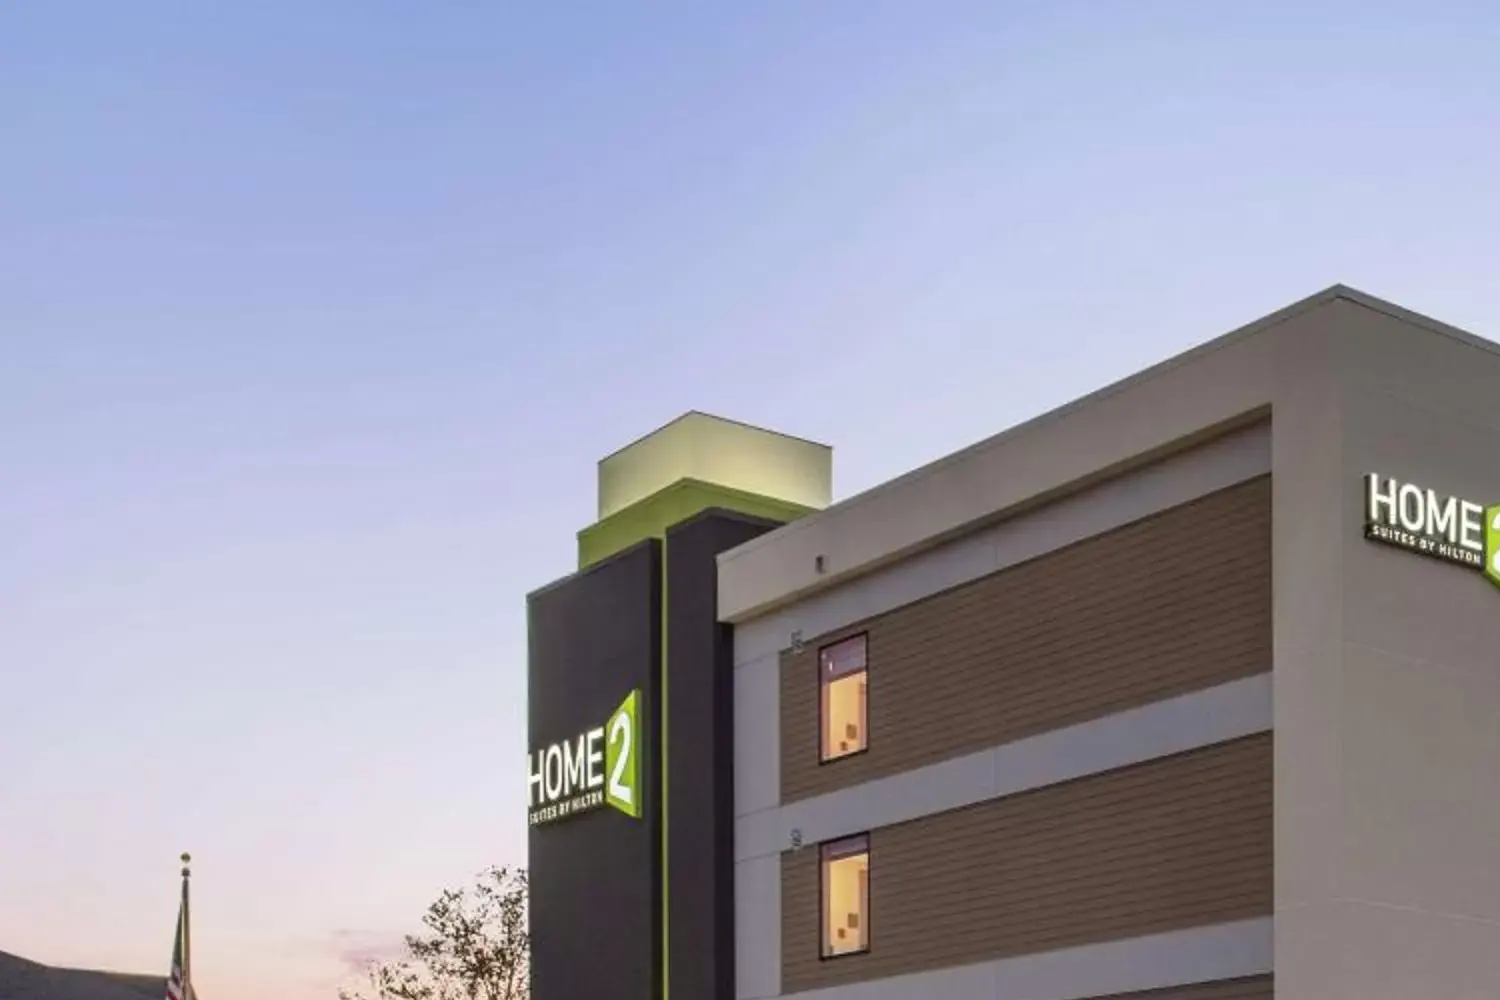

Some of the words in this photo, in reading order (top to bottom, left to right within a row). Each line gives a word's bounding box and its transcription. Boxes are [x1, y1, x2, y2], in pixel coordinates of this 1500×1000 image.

[1370, 472, 1483, 551] HOME
[1372, 525, 1416, 546] SUITES
[1420, 538, 1435, 551] BY
[1439, 543, 1482, 565] HILTON
[527, 726, 604, 807] HOME
[609, 711, 633, 805] 2
